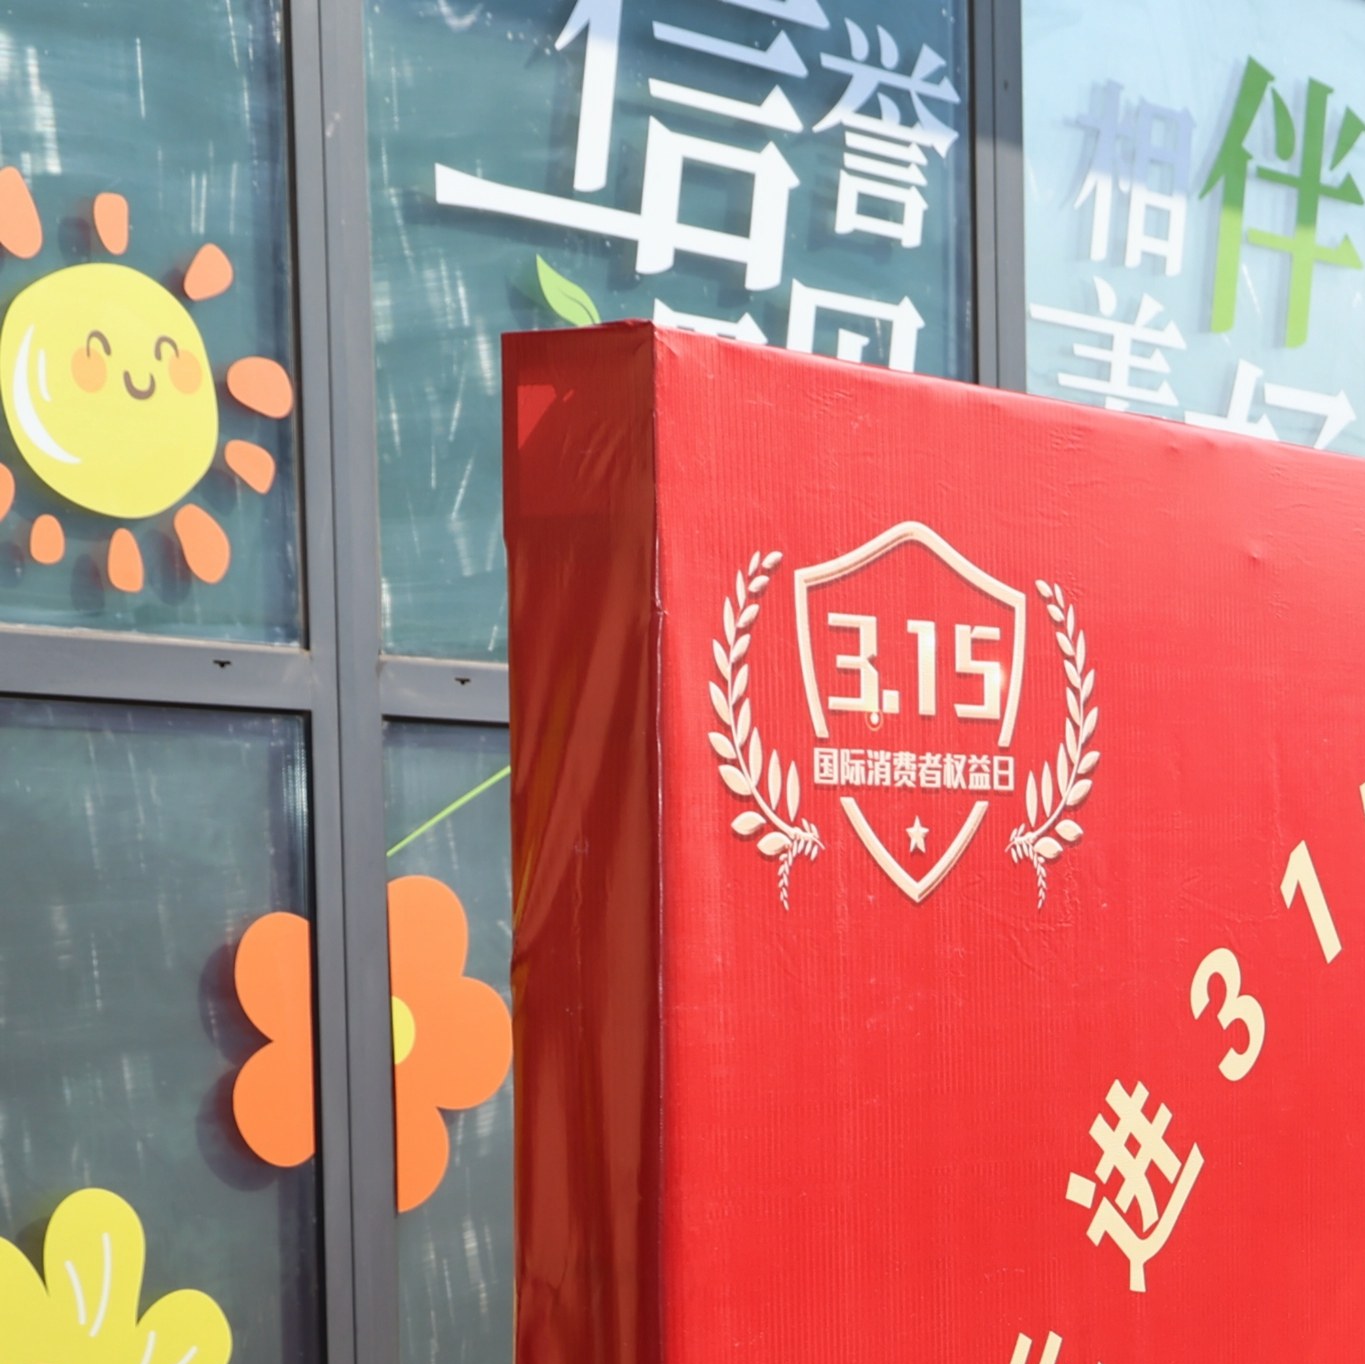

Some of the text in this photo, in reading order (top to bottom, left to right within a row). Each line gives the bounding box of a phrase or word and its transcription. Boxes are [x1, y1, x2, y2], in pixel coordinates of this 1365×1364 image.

[828, 612, 1003, 721] 3.15
[813, 747, 1015, 792] 国际消费者权益日
